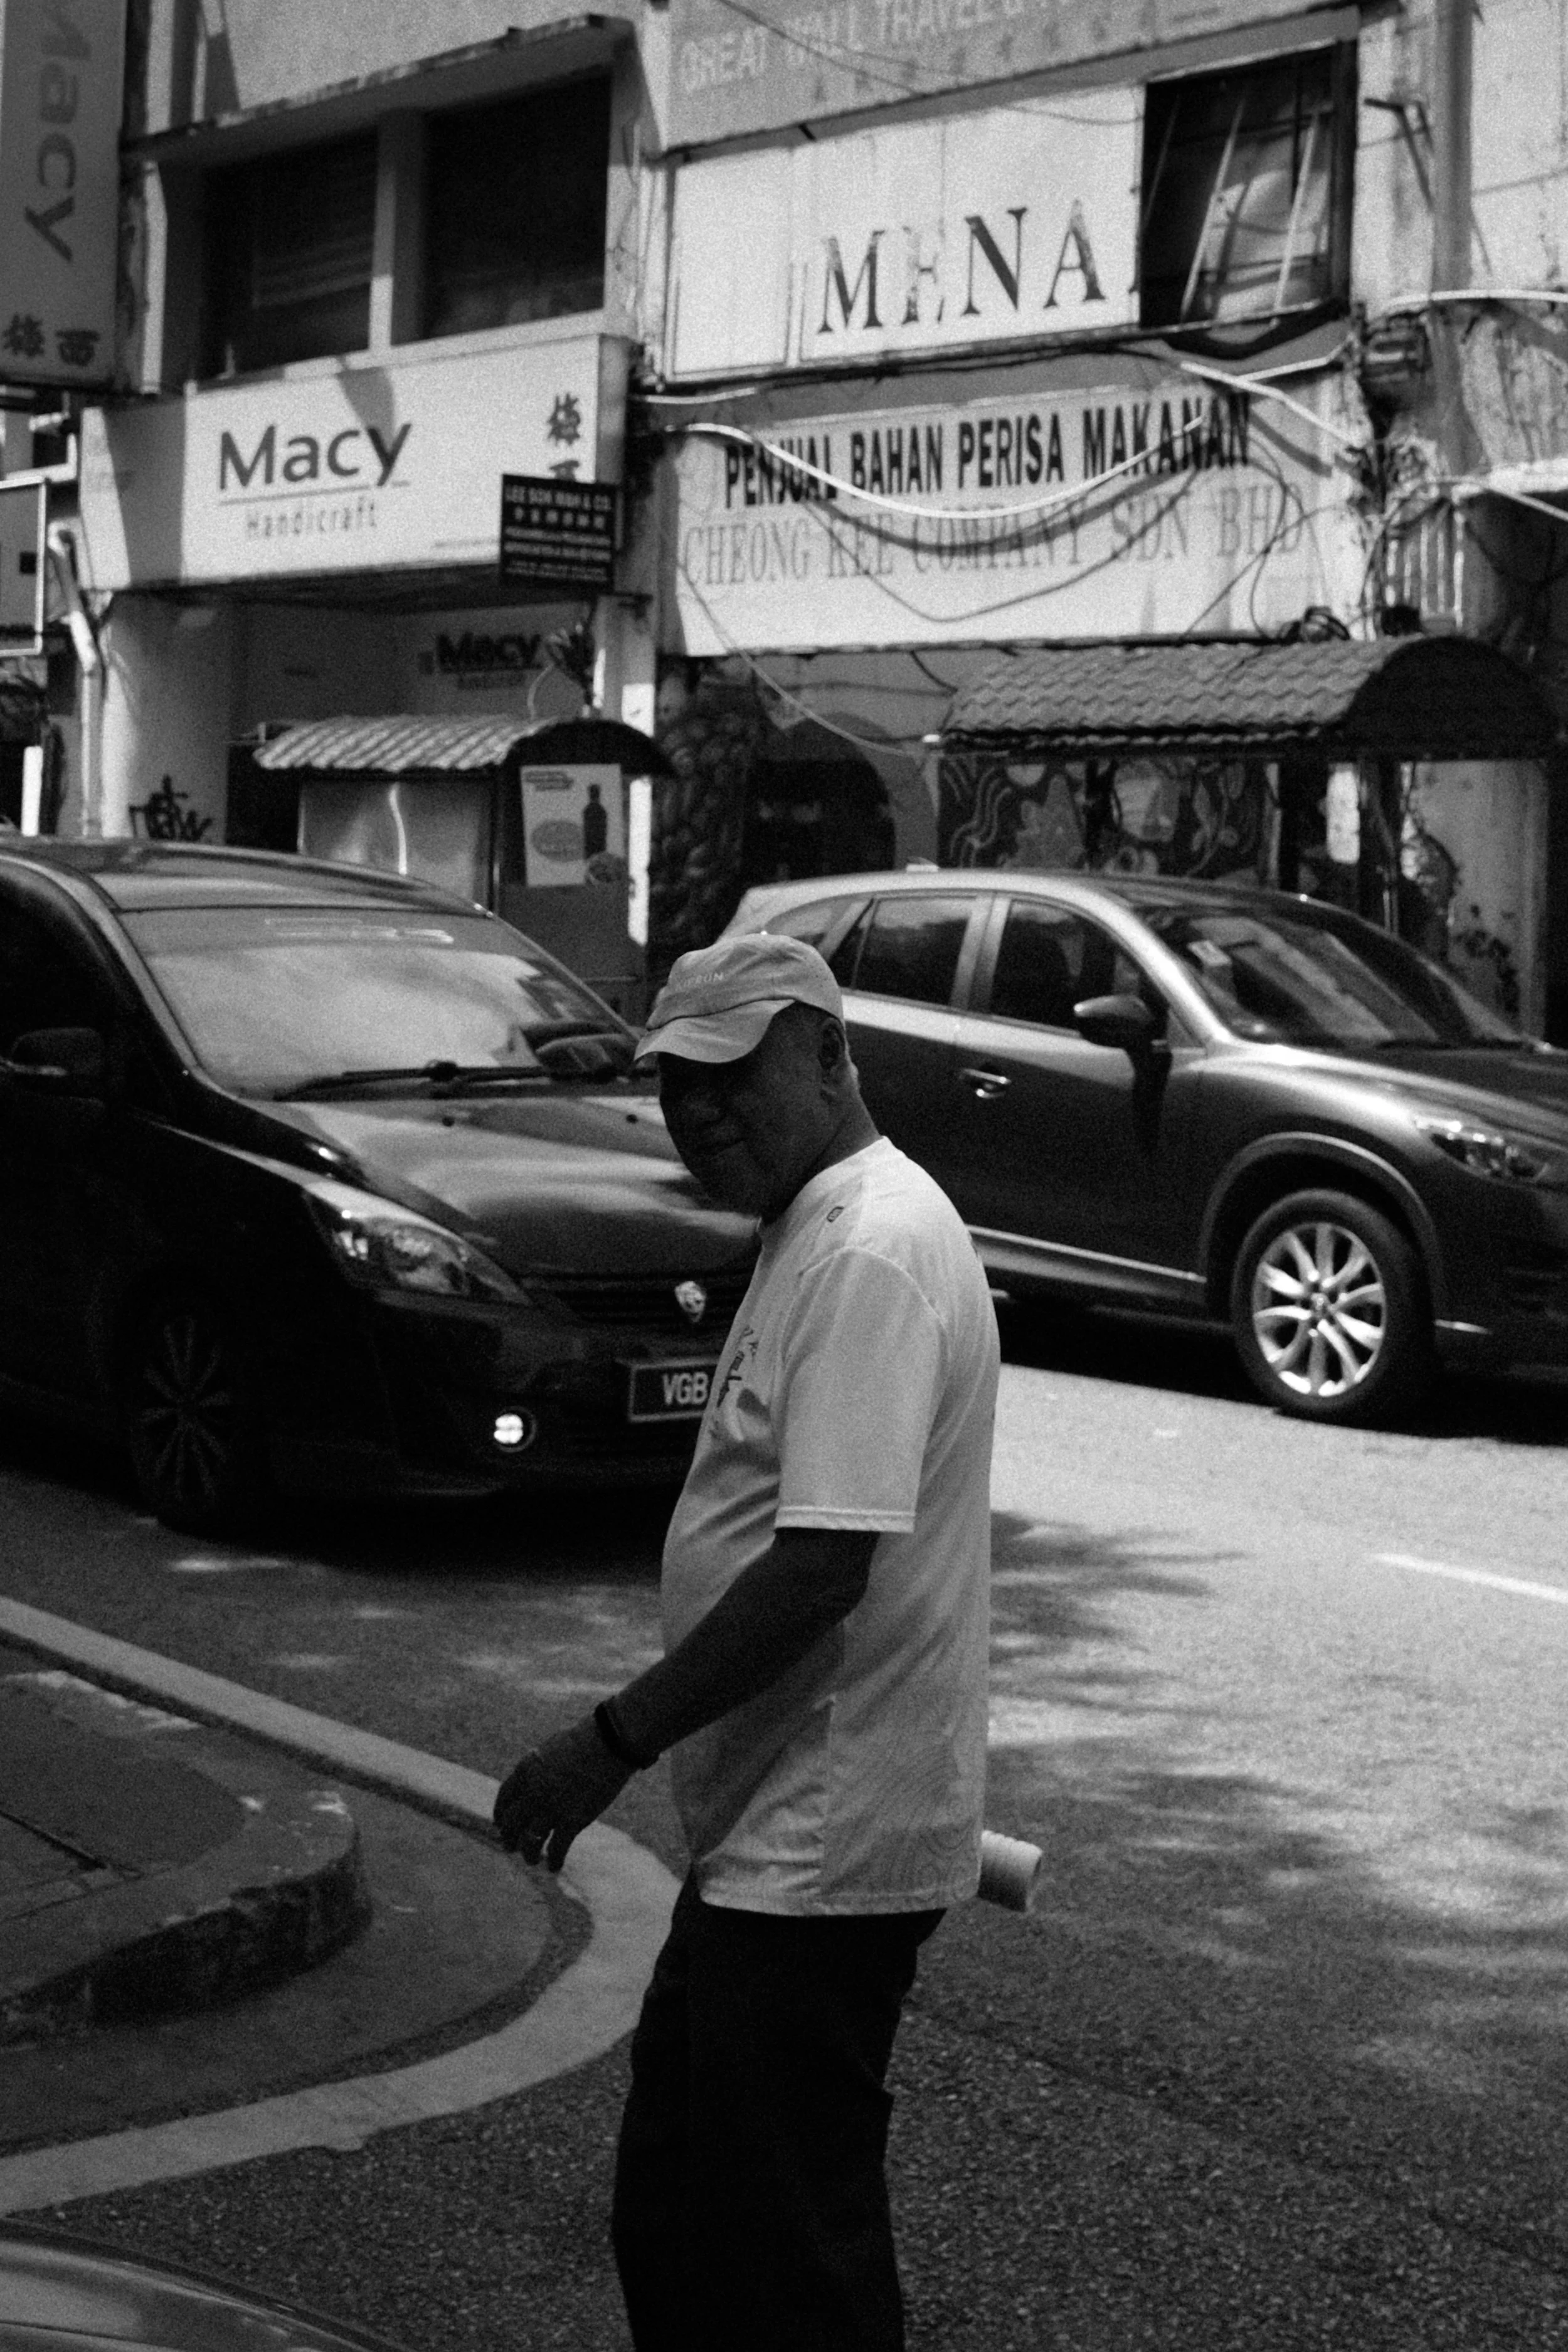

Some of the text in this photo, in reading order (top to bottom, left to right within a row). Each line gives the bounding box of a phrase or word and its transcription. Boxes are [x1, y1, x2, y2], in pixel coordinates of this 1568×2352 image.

[679, 25, 768, 92] GREAT
[220, 423, 412, 490] Macy
[724, 392, 1250, 509] PENJUAL BAHAN PERISA MAKANAN
[661, 1372, 709, 1406] VGB
